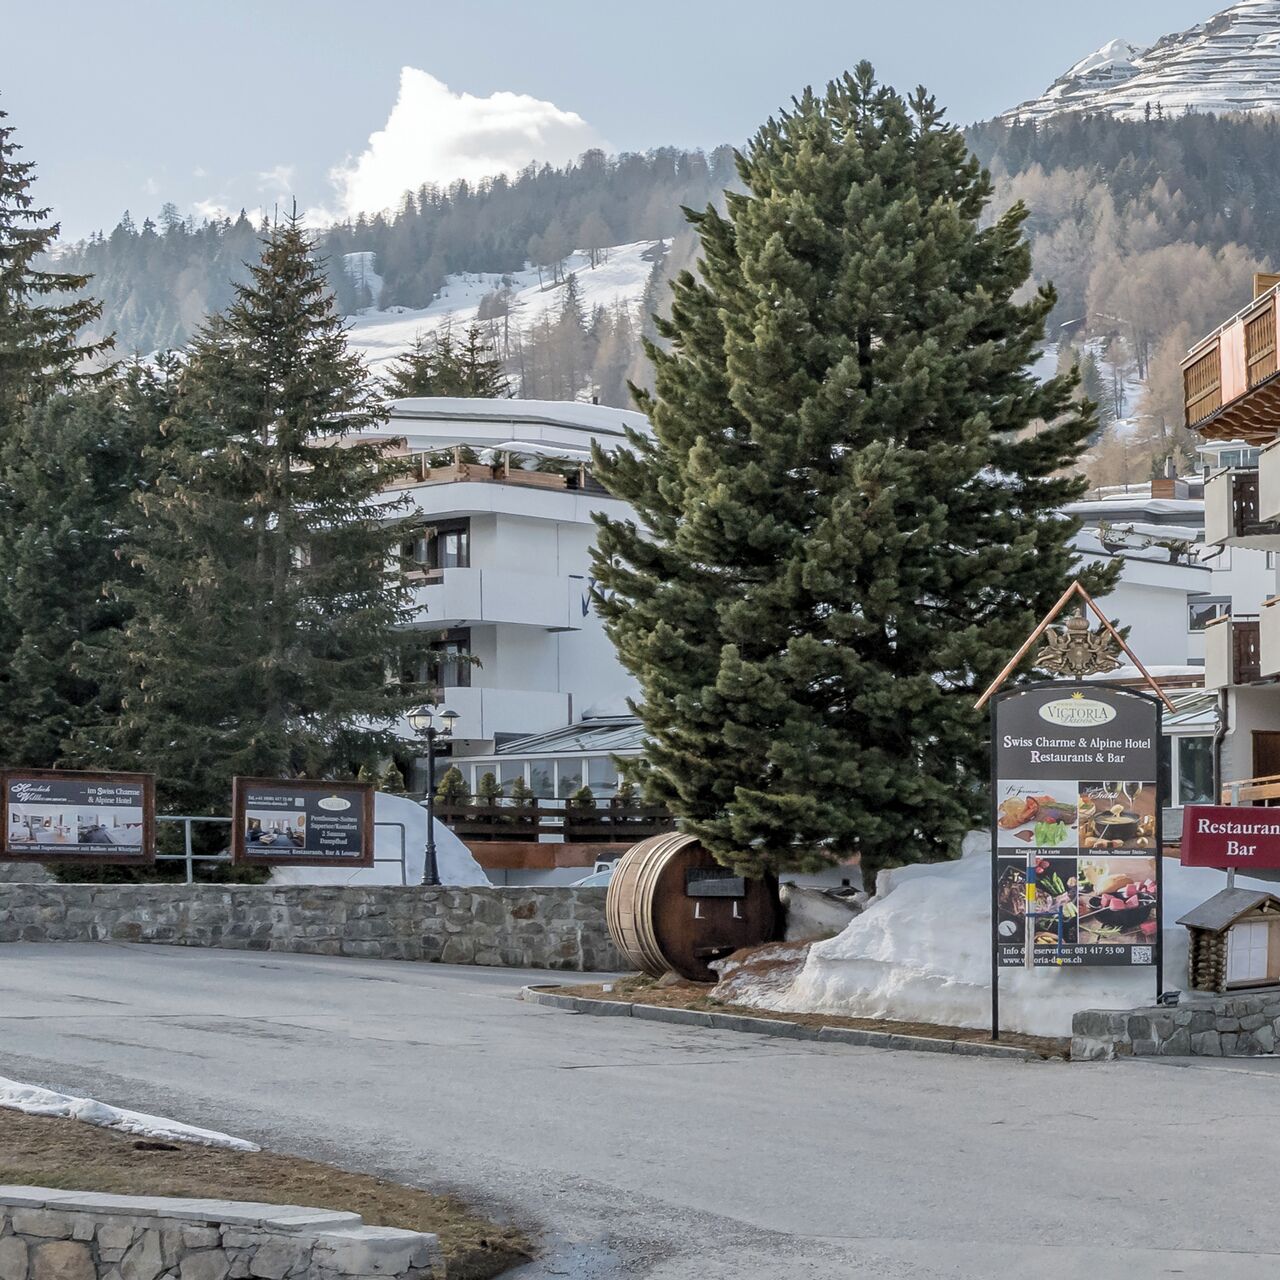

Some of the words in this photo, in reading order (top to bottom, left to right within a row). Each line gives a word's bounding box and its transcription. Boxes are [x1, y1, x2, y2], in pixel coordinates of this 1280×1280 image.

[1047, 706, 1109, 722] VICTORIA
[1003, 735, 1033, 748] Swiss
[1035, 737, 1076, 748] Charme
[1078, 737, 1088, 748] &
[1090, 737, 1122, 750] Alpine
[1125, 738, 1151, 749] Hotel
[1030, 750, 1093, 763] Restaurants
[1095, 753, 1104, 763] &
[1107, 753, 1126, 763] Bar
[97, 787, 115, 795] Swiss
[95, 796, 115, 805] Alpine
[1226, 840, 1257, 856] Bar
[1003, 946, 1019, 955] Info
[1074, 946, 1088, 954] 081
[1089, 946, 1103, 954] 417
[1104, 946, 1114, 954] 53
[1115, 946, 1125, 954] 00
[1003, 956, 1082, 964] www.voria-dvos.ch
